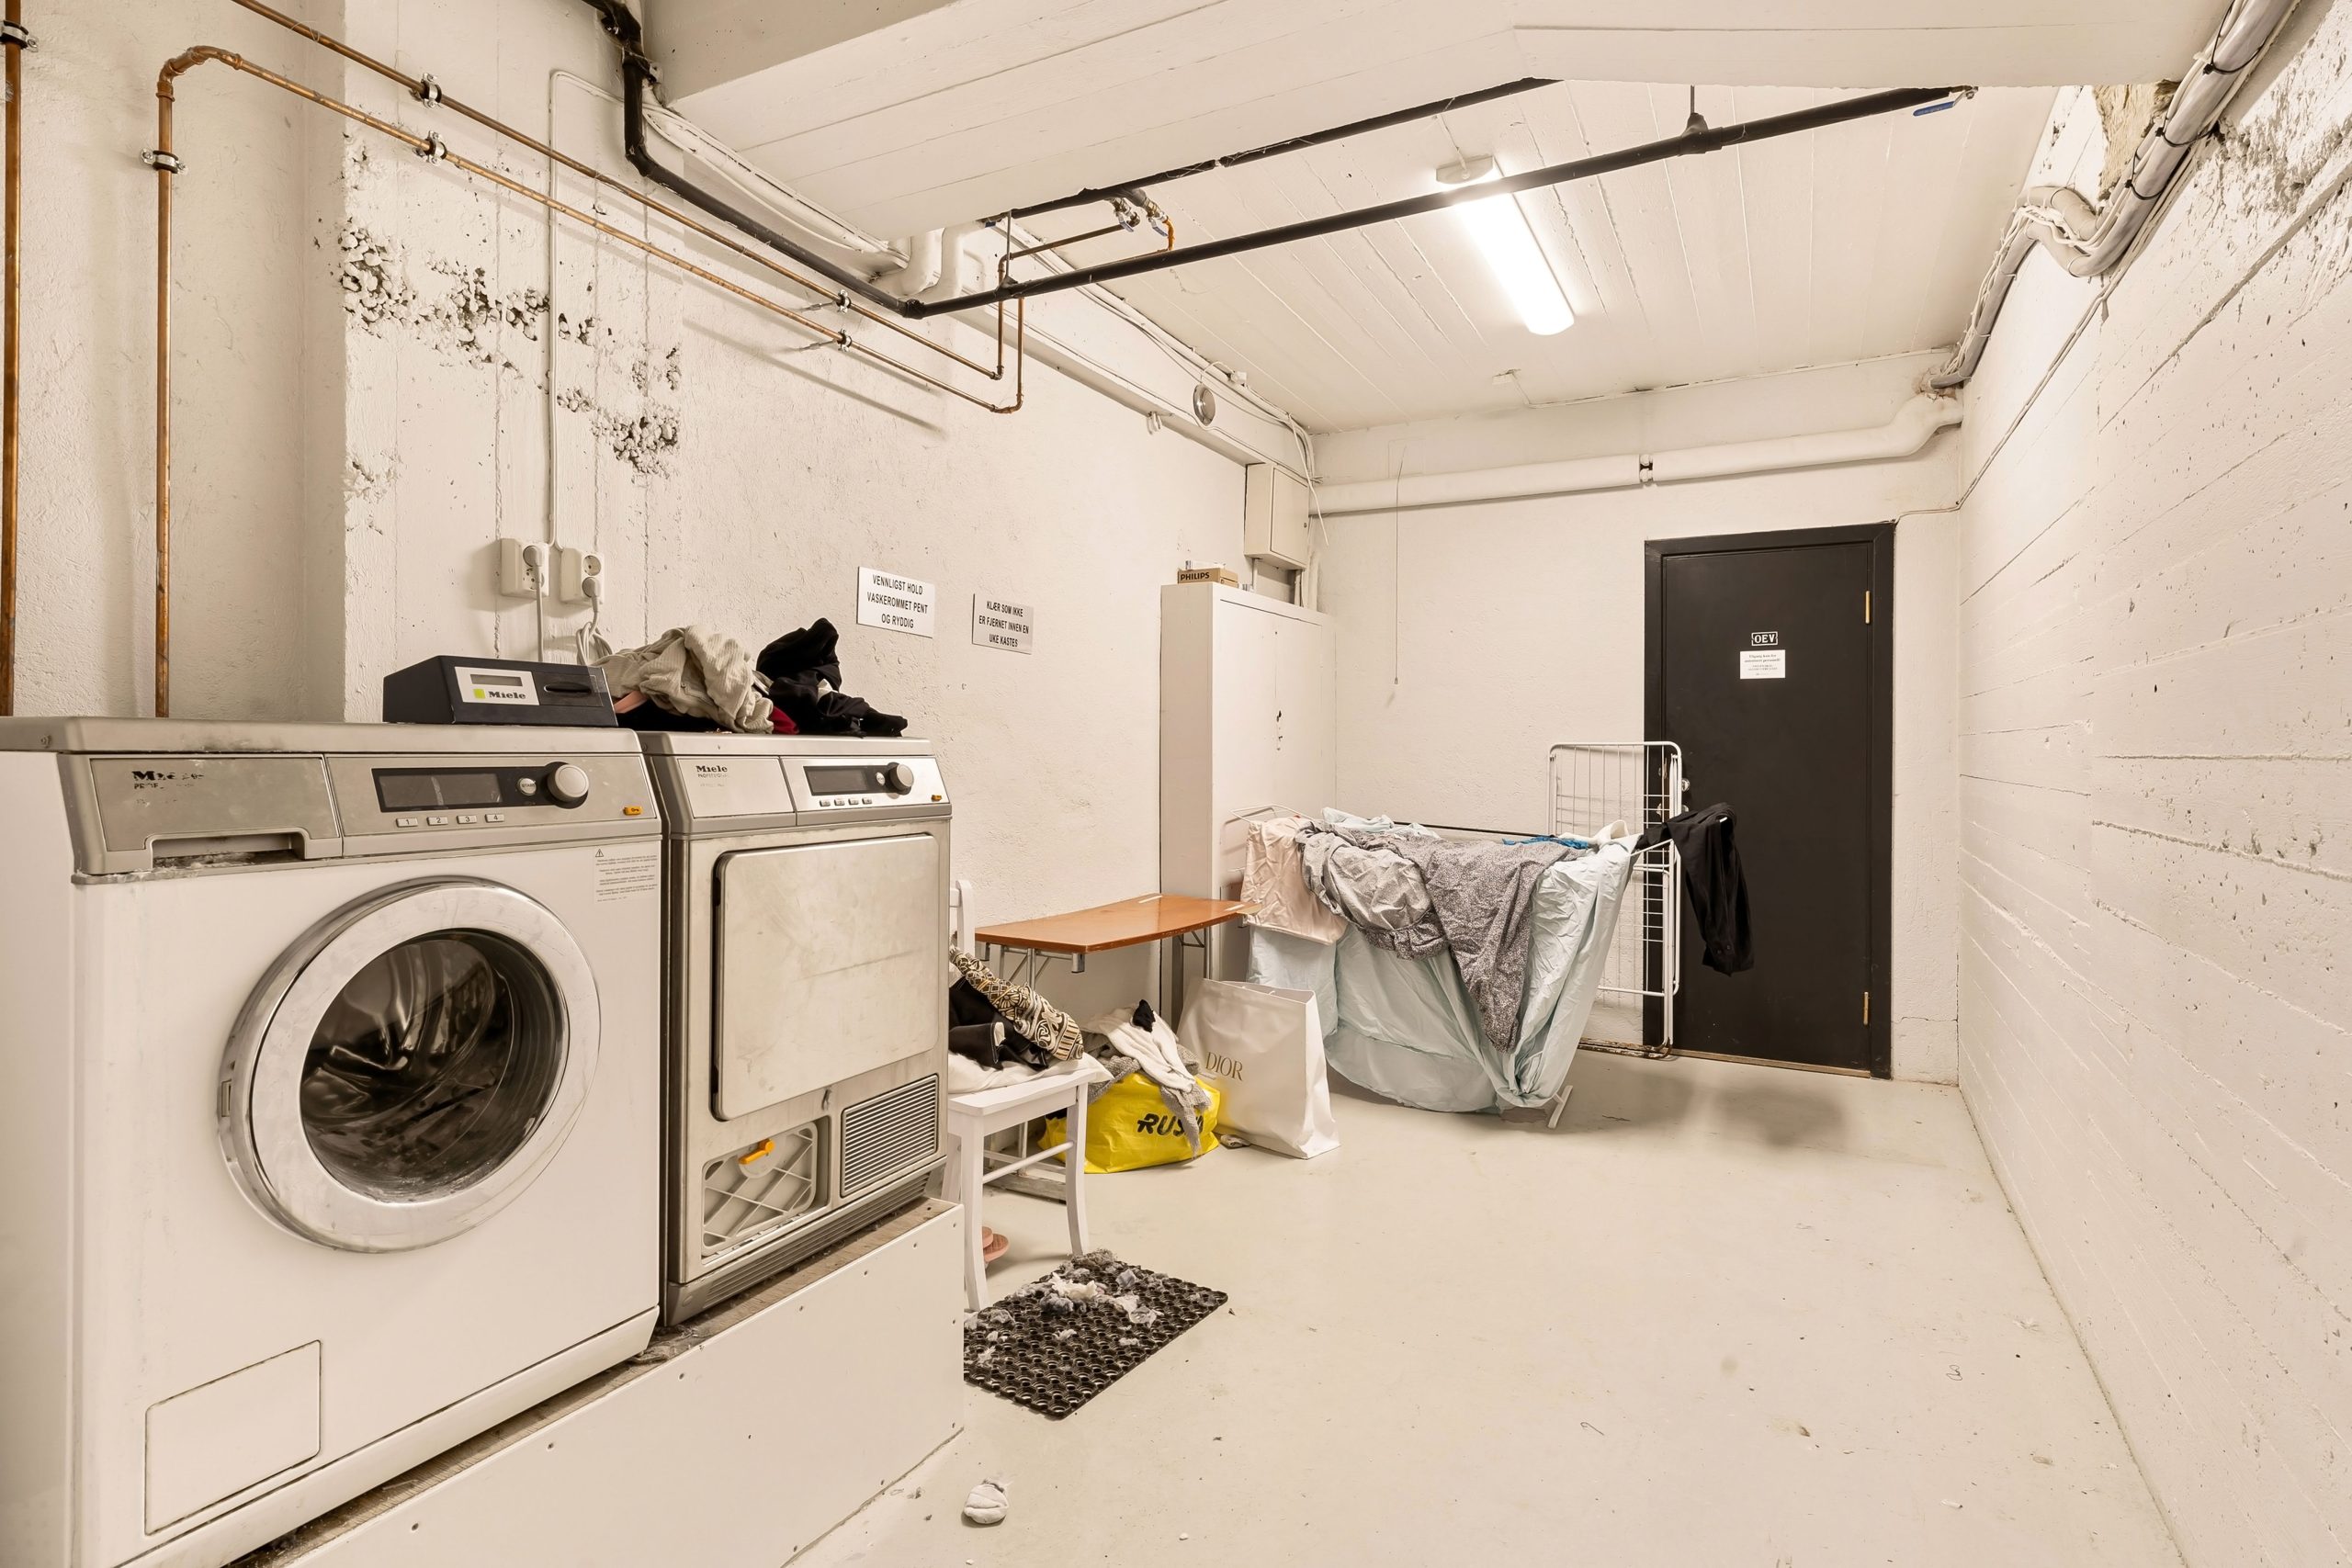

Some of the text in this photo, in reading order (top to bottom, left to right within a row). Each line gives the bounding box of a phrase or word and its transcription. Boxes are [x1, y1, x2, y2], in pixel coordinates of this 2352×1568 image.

[1181, 571, 1210, 581] PHILIPS
[872, 574, 923, 595] VENNLIGST HOLD
[866, 592, 929, 614] VASKEROMMET PENT
[986, 601, 1023, 617] KLÆR SOM IKKE
[881, 614, 914, 628] OG RYDDIG
[978, 615, 1029, 634] ER FJERNET INNEN EN
[989, 634, 1018, 648] UKE KASTES
[1754, 634, 1775, 644] OEV
[488, 691, 526, 699] Miele
[1205, 1052, 1243, 1081] DIOR
